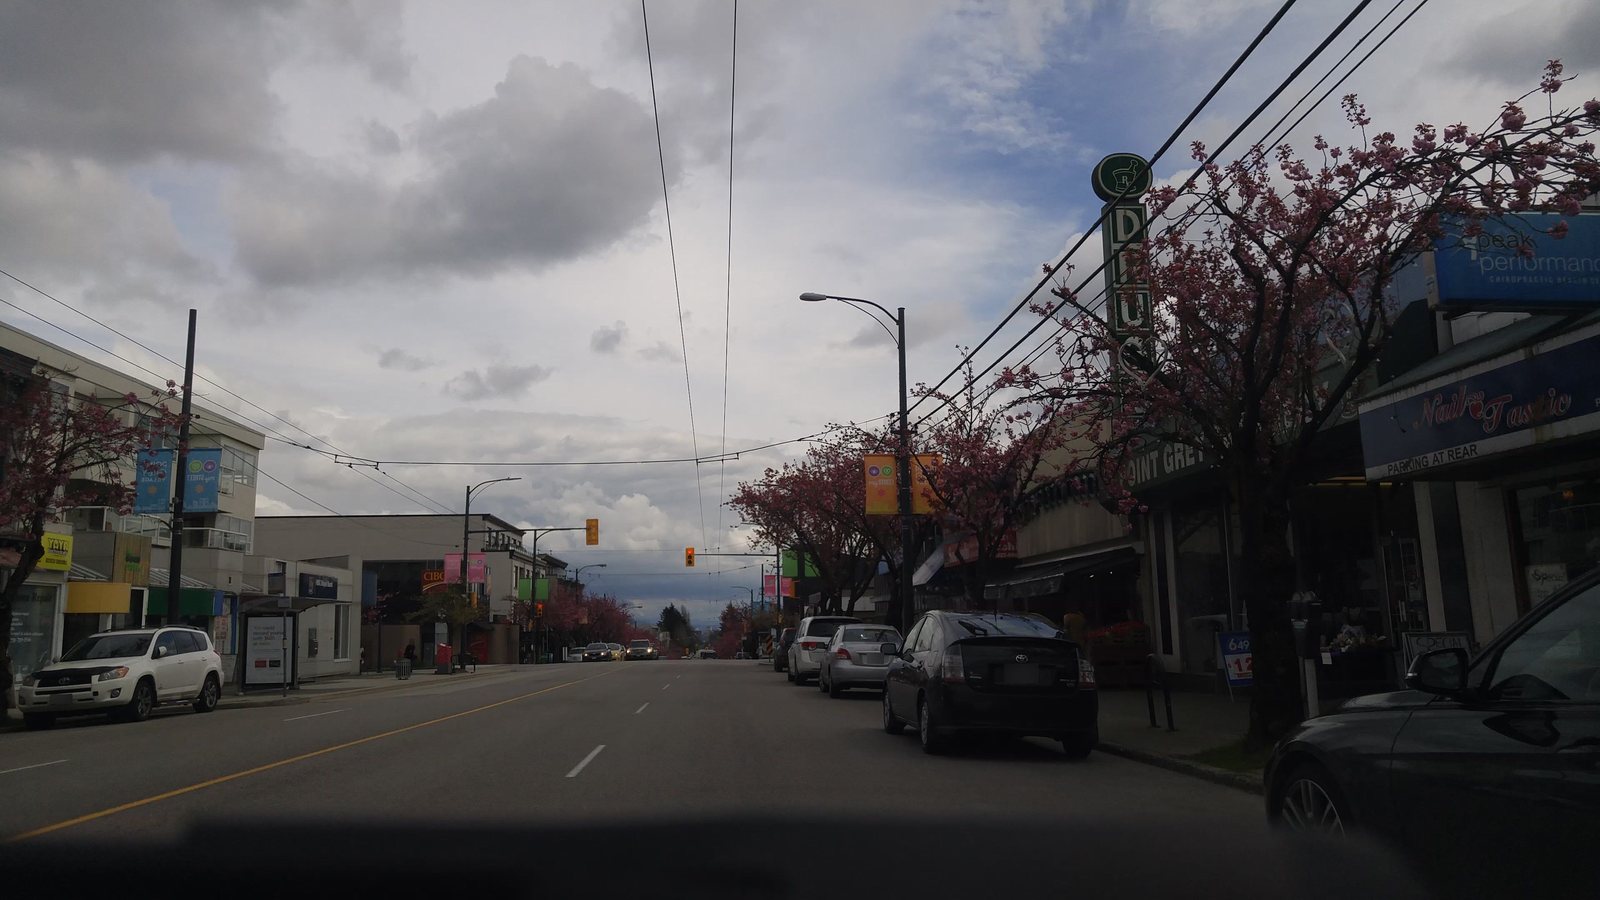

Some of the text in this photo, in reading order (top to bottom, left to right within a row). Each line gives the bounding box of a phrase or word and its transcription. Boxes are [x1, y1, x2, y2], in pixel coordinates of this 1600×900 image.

[1477, 230, 1533, 253] peak
[1120, 449, 1158, 487] OINT
[1387, 444, 1479, 475] PARKING AT REAR
[1228, 638, 1250, 651] 649
